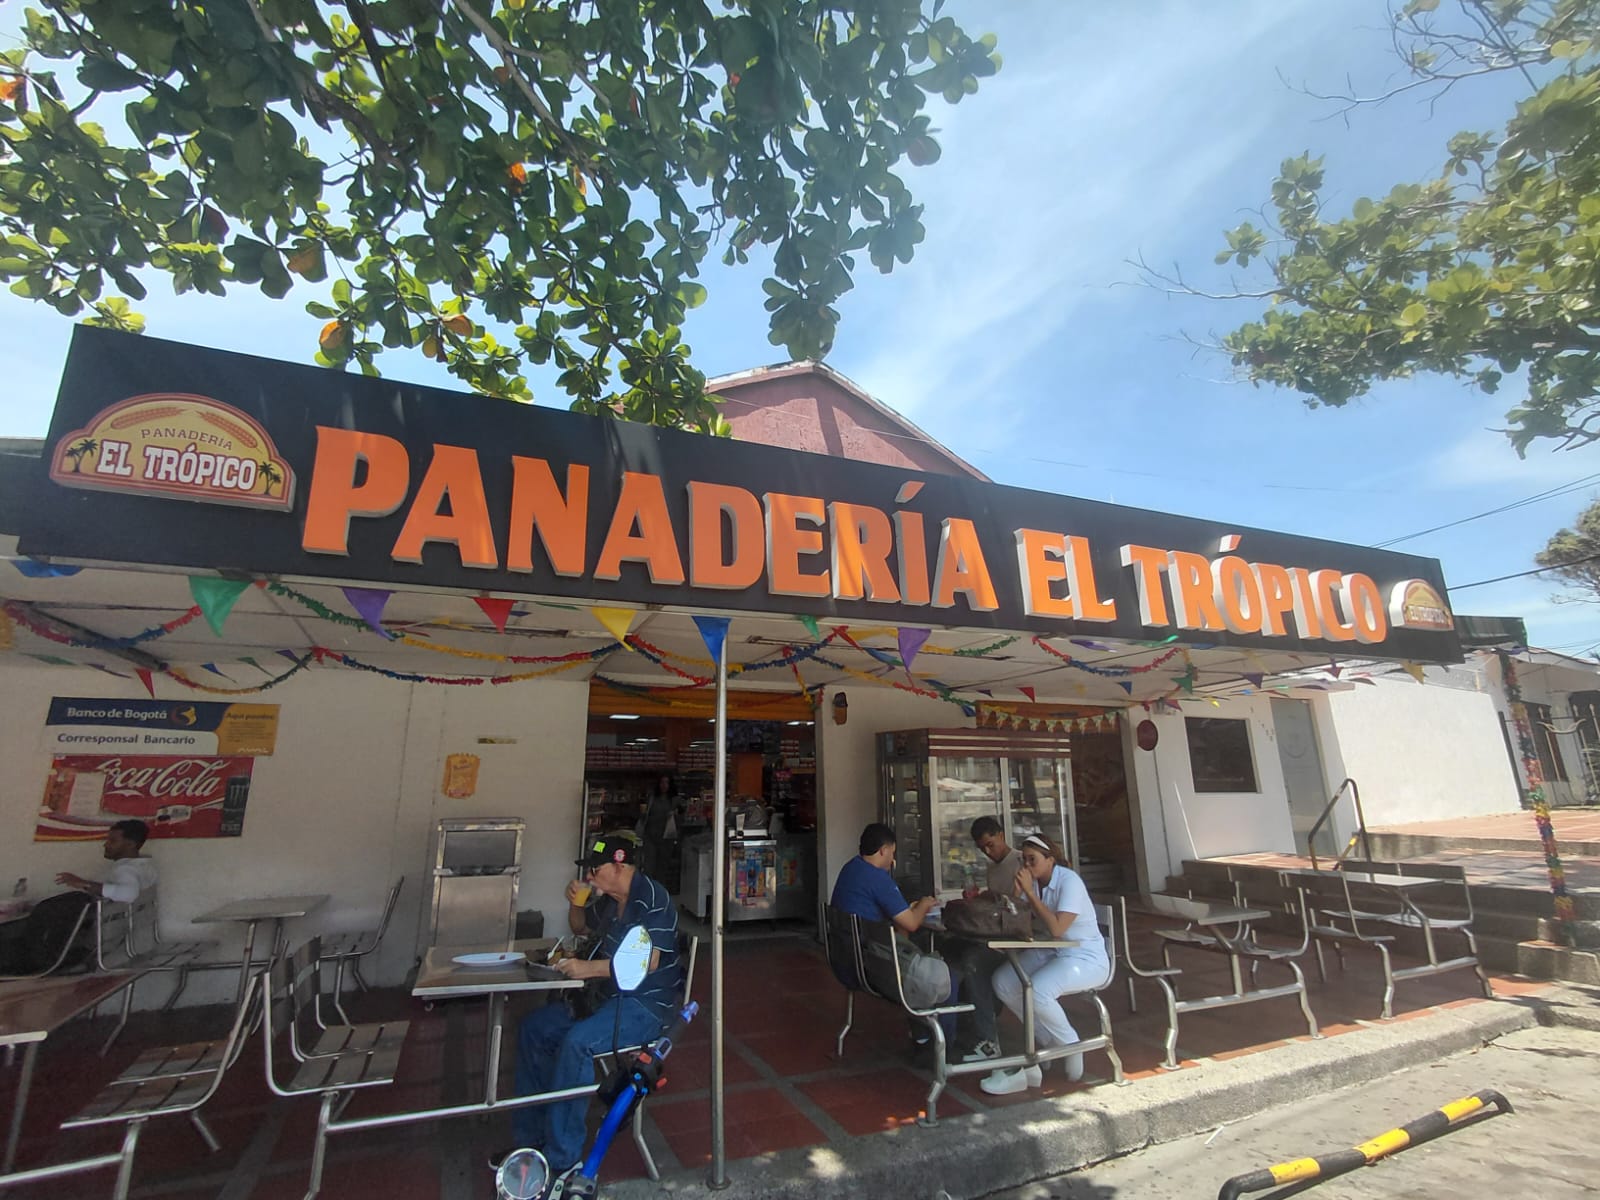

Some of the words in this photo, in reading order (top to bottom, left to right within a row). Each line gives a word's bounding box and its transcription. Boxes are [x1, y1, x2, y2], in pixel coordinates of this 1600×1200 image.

[97, 440, 133, 476] EL
[144, 443, 257, 490] TRÓPICO
[302, 425, 999, 611] PANADERÍA
[1014, 528, 1117, 622] EL
[1120, 534, 1387, 644] TRÓPICO
[67, 707, 106, 718] Banco
[107, 708, 122, 718] de
[124, 709, 168, 721] Bogotá
[57, 733, 139, 744] Corresponsal
[144, 734, 196, 745] Bancario
